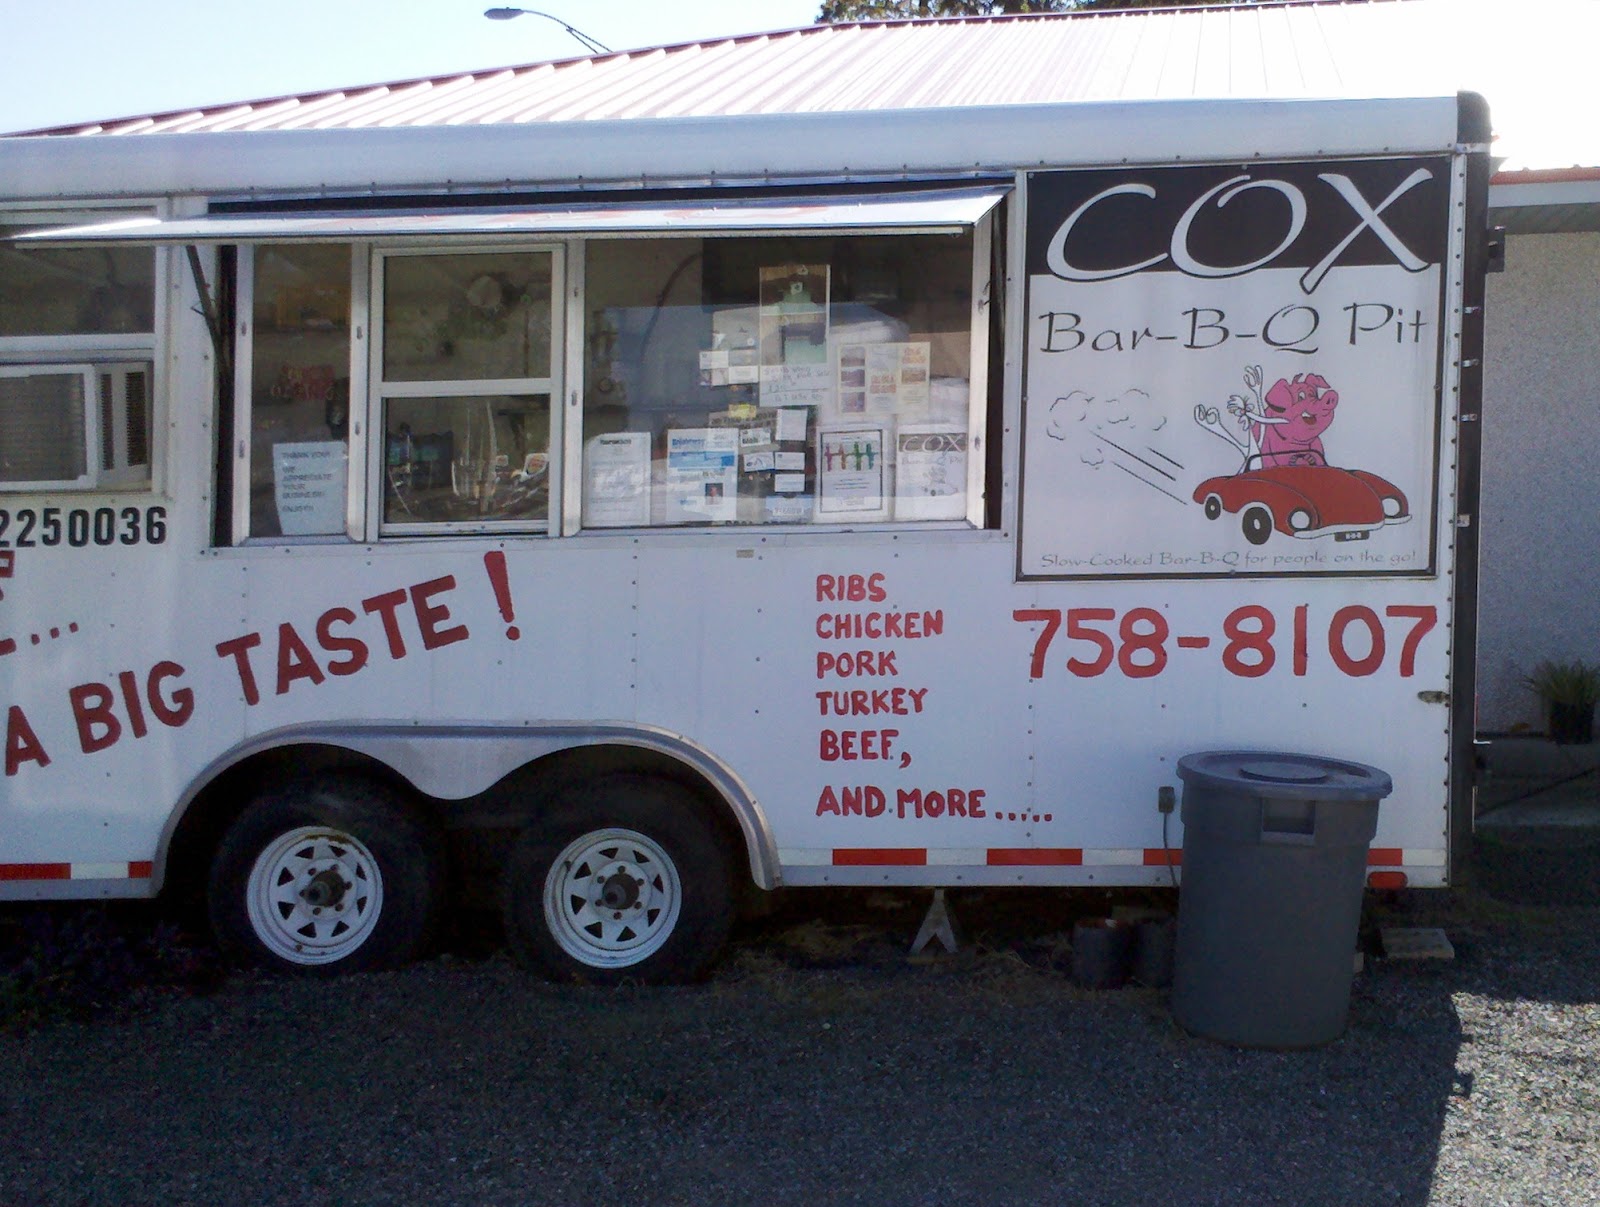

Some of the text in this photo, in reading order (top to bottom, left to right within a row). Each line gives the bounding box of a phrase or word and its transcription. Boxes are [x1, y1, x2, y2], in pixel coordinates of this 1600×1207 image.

[1046, 167, 1434, 295] COX
[1038, 302, 1428, 355] Bar-B-Q Pit
[902, 433, 964, 457] COX
[1041, 550, 1416, 568] Slow-Cooked Bar-B-Q for people on the go!
[815, 572, 888, 604] RIBS
[815, 609, 944, 640] CHICKEN
[1013, 604, 1438, 679] 758-8107
[816, 649, 899, 679] PORK
[815, 686, 928, 718] TURKEY
[5, 705, 52, 777] A
[69, 660, 195, 755] BIG
[816, 785, 886, 818] AND
